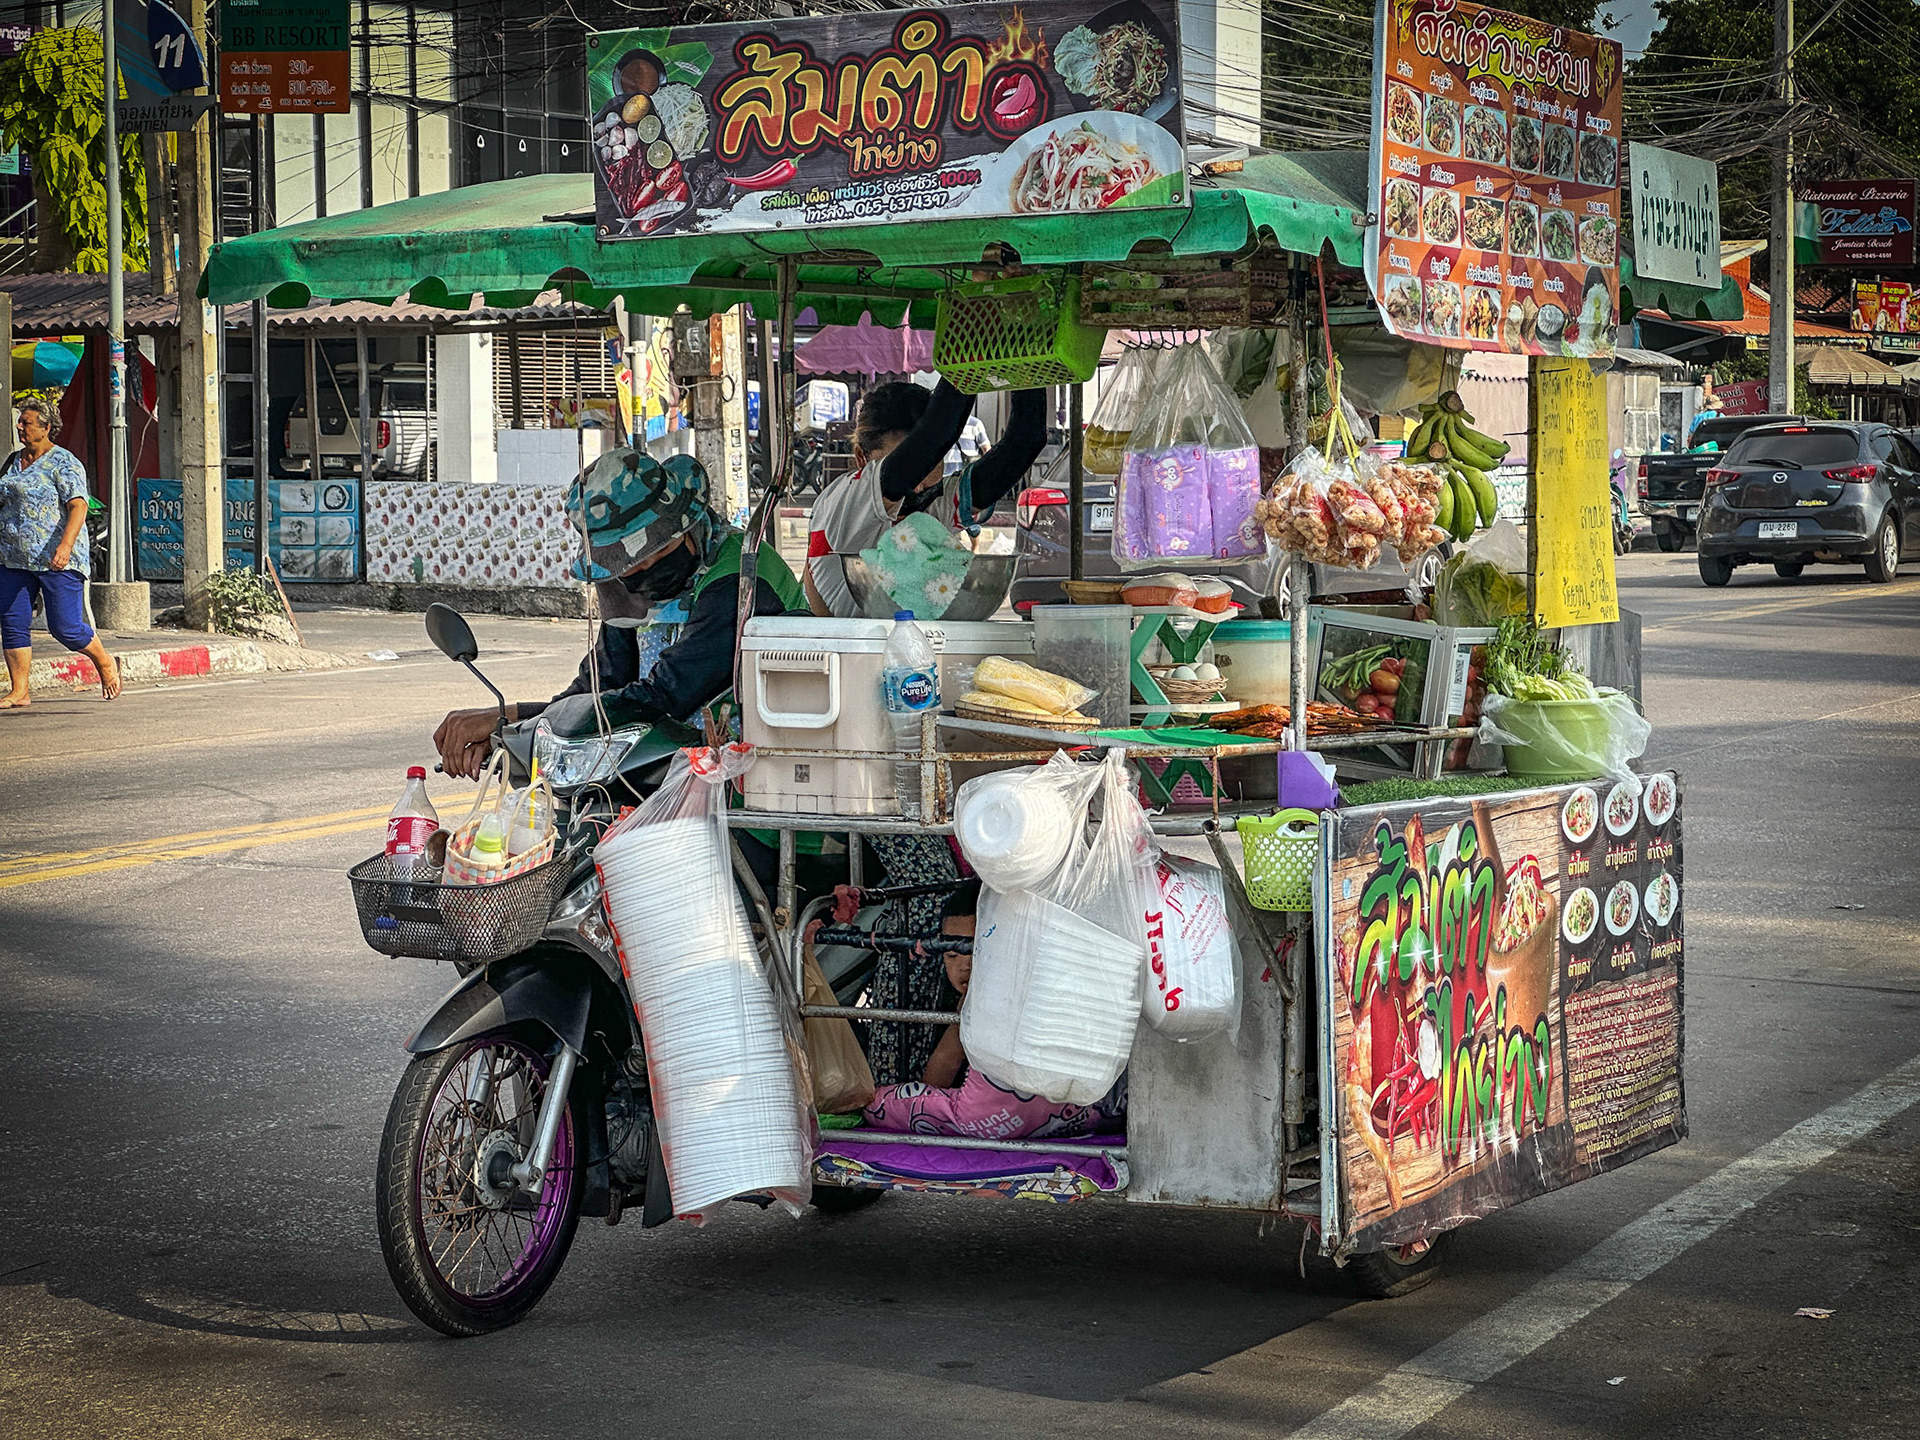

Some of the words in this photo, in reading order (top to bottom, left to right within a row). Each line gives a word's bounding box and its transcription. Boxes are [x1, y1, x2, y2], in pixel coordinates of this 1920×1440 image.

[232, 27, 255, 46] BB
[264, 26, 342, 46] RESORT
[155, 34, 185, 68] 11
[718, 18, 986, 156] ส้มตำ
[118, 98, 193, 120] จอมเทียน
[119, 120, 168, 132] JOMTIEN
[844, 131, 938, 172] ไก่ย่าง
[761, 190, 801, 209] รสเด็ด
[805, 187, 830, 205] เผ็ด
[940, 170, 981, 187] 100%
[1798, 188, 1858, 201] Ristorante
[1860, 187, 1910, 200] Pizzeria
[855, 194, 948, 215] 065-6374397
[1831, 240, 1865, 251] Jomtien
[1867, 239, 1893, 248] Beach
[1721, 397, 1747, 410] oilet
[901, 686, 920, 697] Pure
[920, 684, 933, 697] Life
[1567, 852, 1590, 876] ตำไทย
[1352, 817, 1496, 1005] ส้มตำ
[1610, 943, 1637, 971] ตำปูม้า
[1424, 976, 1553, 1162] ไก่ย่าง
